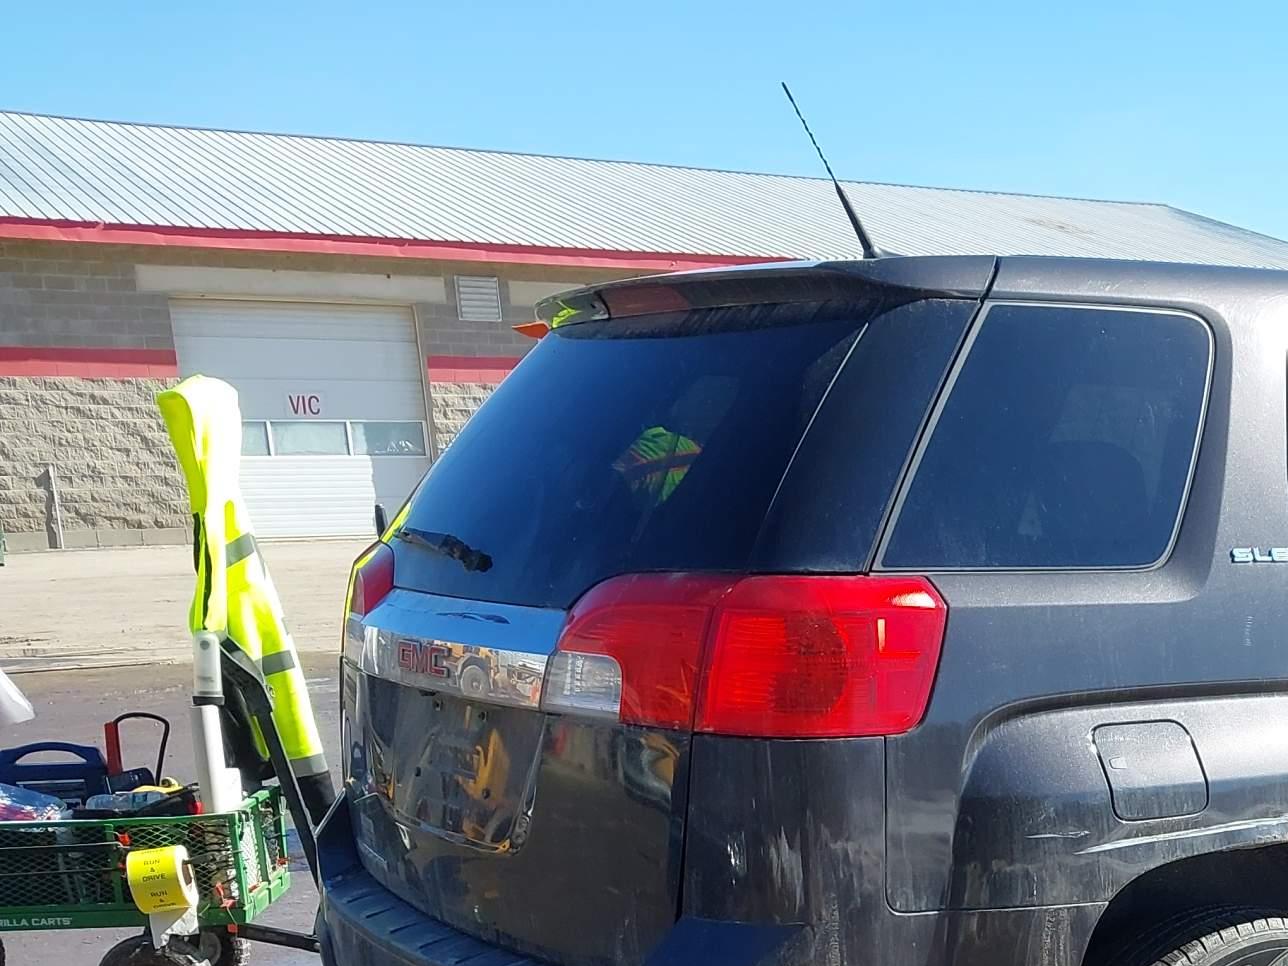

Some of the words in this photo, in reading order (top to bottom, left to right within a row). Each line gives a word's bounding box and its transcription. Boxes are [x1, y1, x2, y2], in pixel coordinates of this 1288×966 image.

[288, 394, 321, 415] VIC
[398, 639, 450, 679] GMC
[142, 872, 167, 882] DRIVE
[31, 917, 71, 926] CARTS
